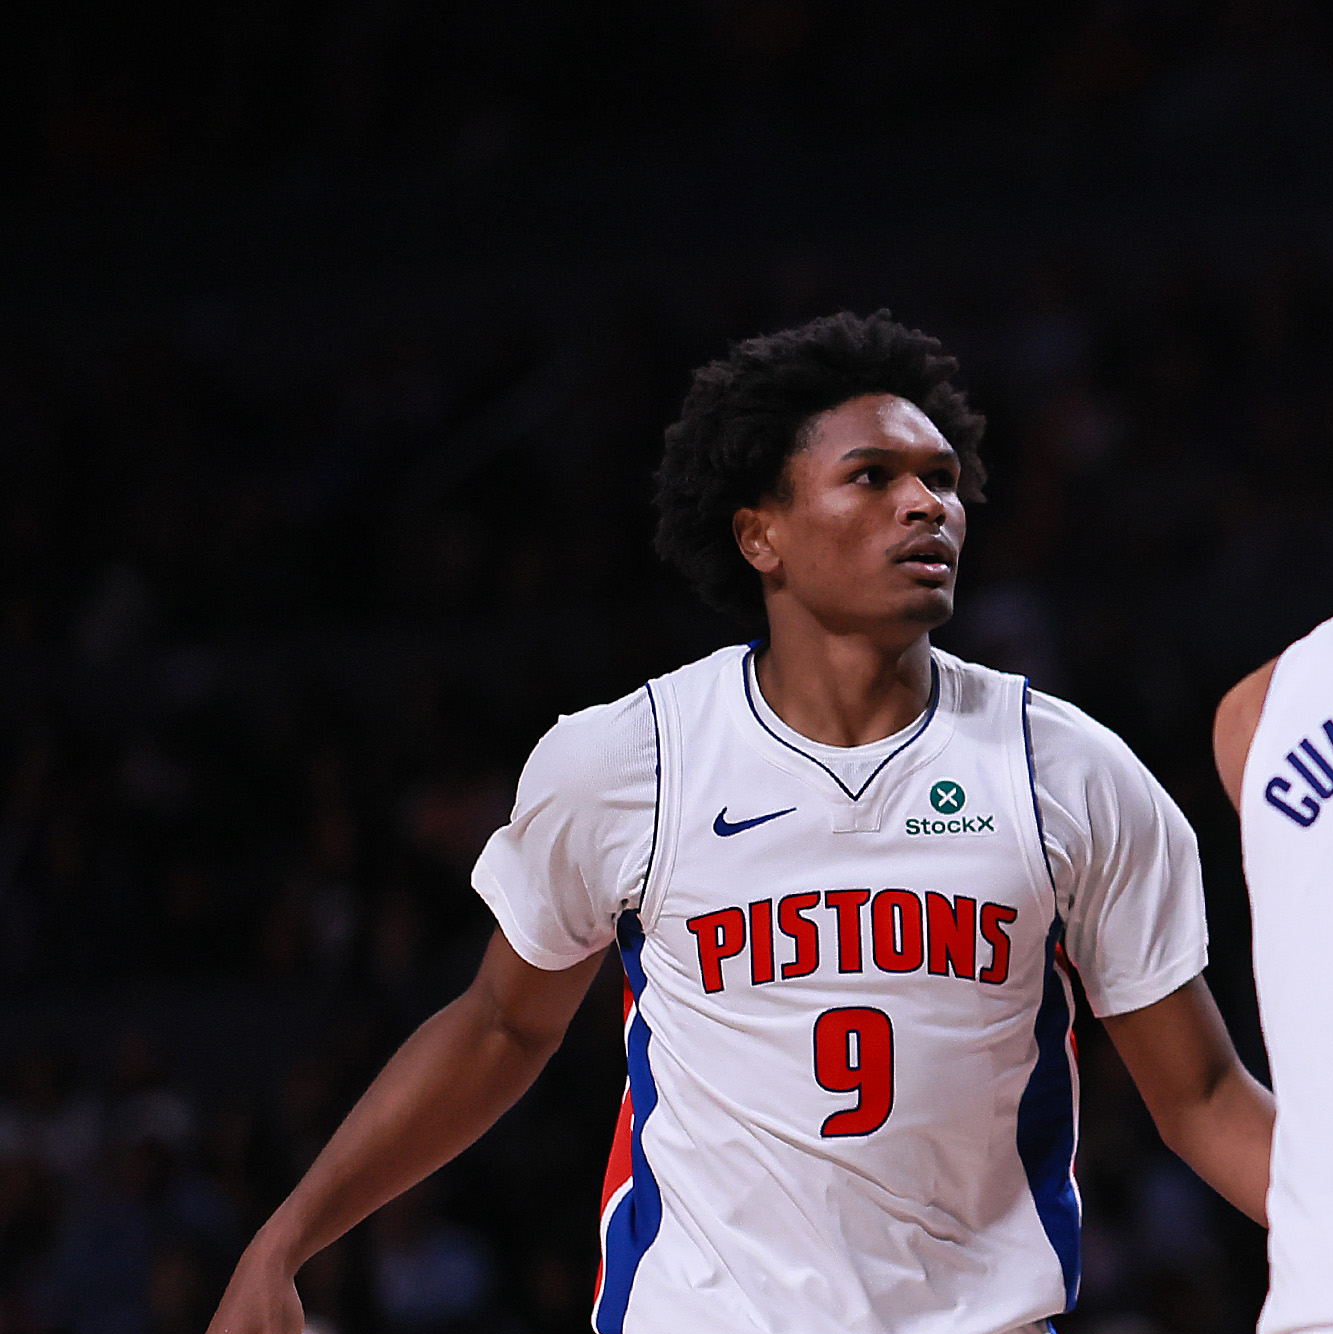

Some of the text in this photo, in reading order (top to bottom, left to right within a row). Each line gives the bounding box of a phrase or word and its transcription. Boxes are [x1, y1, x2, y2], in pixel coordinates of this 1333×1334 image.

[905, 814, 995, 836] StockX
[686, 888, 1019, 995] PISTONS
[812, 1006, 896, 1139] 9
